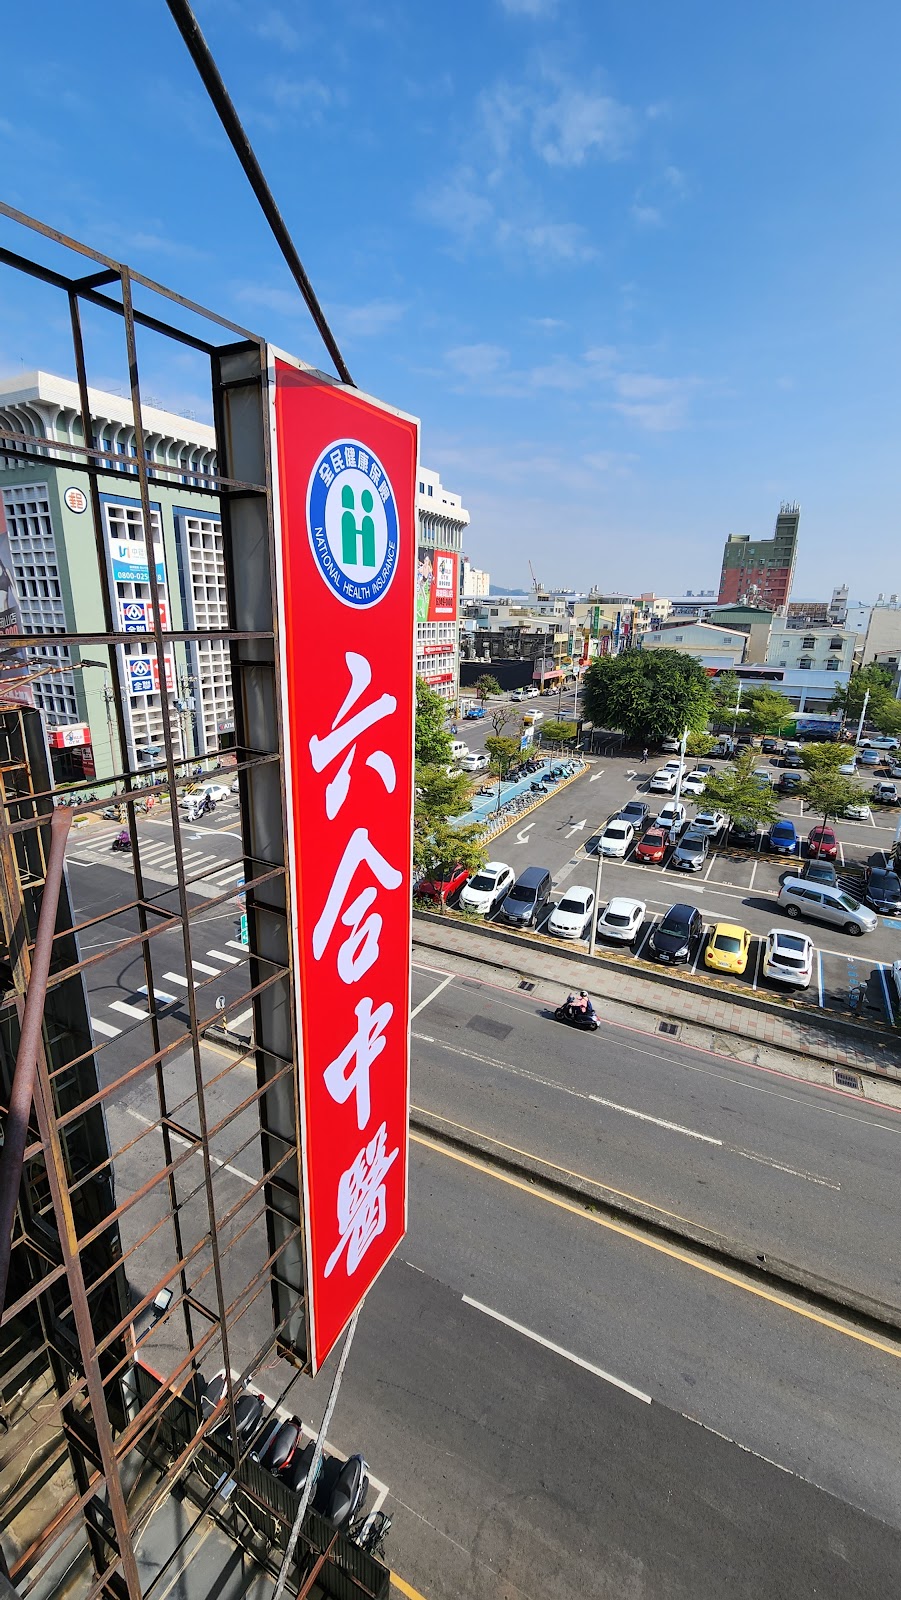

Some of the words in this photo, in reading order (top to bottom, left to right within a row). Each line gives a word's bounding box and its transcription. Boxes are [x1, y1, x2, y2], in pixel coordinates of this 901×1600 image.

[318, 446, 391, 504] 全民健康保險
[68, 491, 84, 509] 郵
[117, 571, 162, 581] 0800-0258
[314, 527, 341, 587] NATIONAL
[342, 581, 371, 600] HEALTH
[372, 541, 396, 595] INSURANCE
[133, 680, 152, 691] 全聯
[308, 651, 403, 1279] 六合中醫
